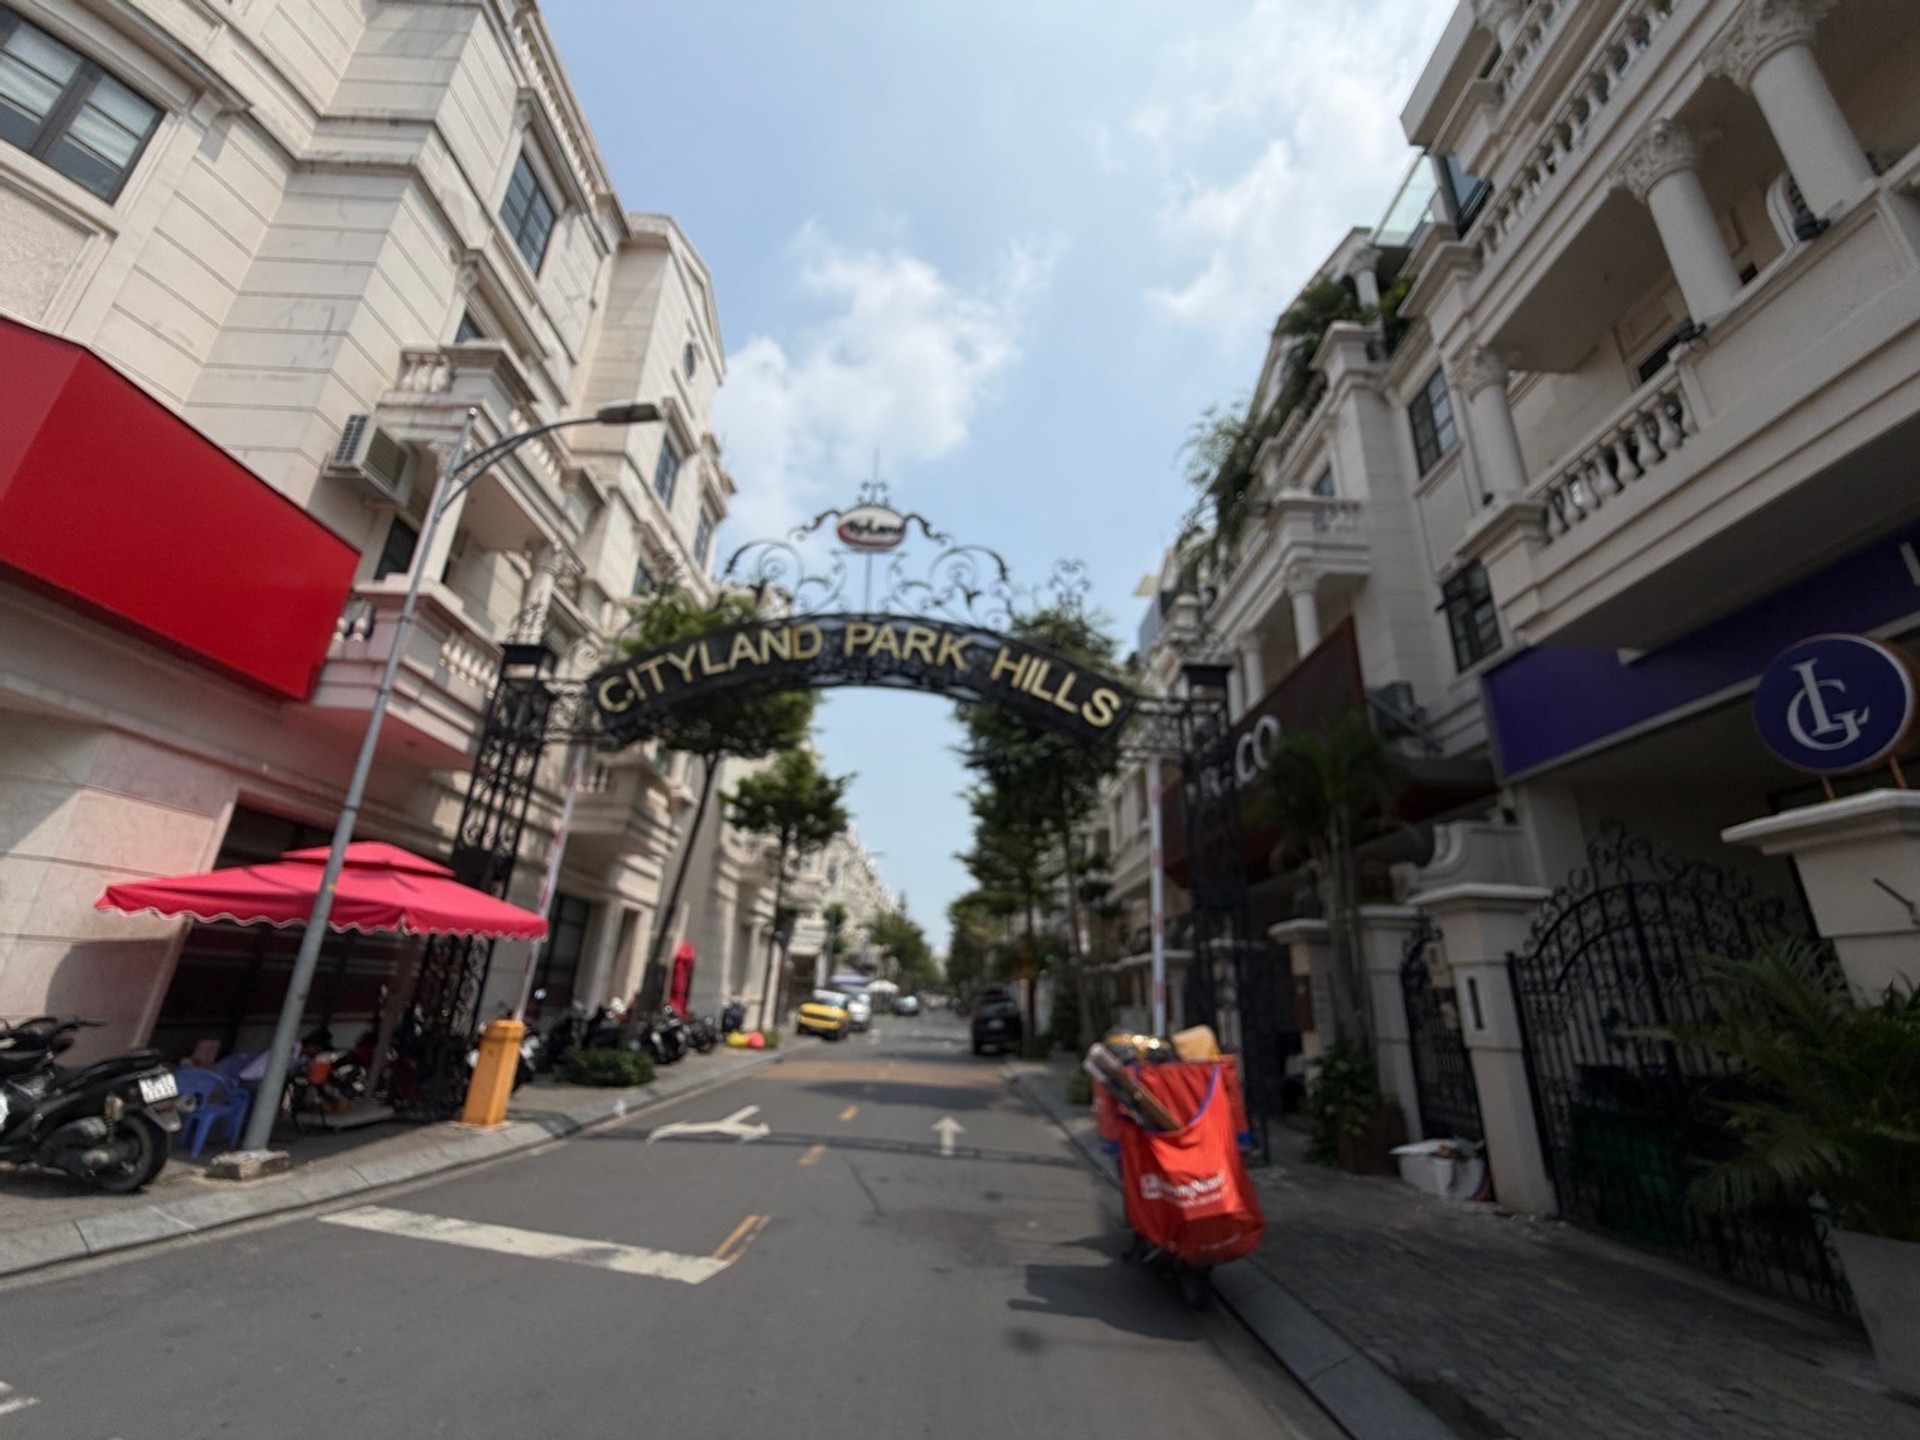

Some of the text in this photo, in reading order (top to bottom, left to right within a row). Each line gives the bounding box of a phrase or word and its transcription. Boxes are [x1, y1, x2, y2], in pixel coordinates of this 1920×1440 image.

[598, 622, 1122, 727] CITYLAND PARK HILLS
